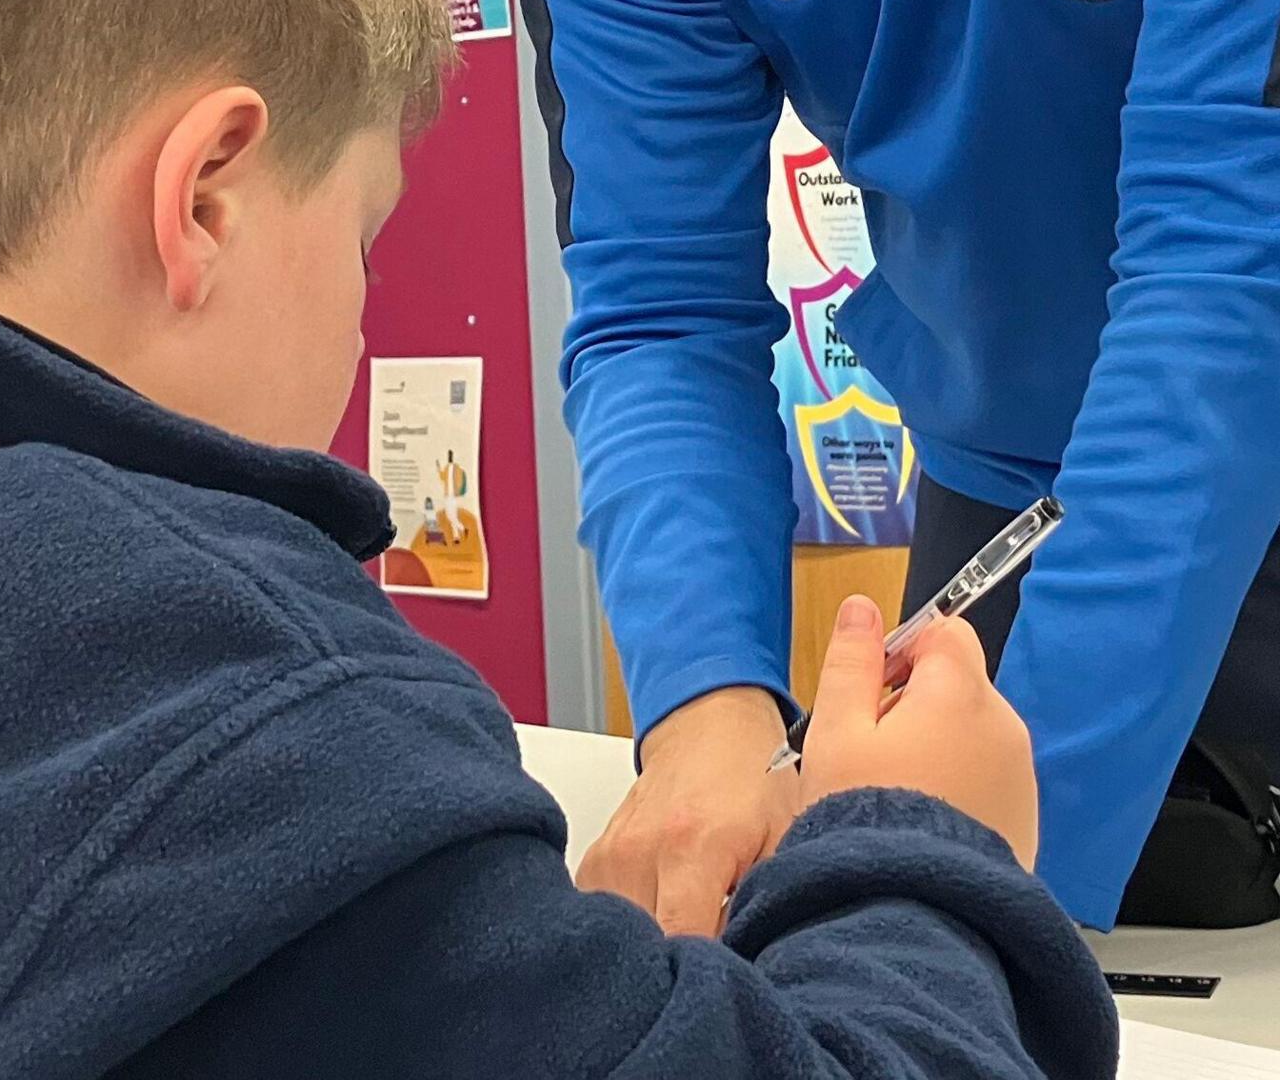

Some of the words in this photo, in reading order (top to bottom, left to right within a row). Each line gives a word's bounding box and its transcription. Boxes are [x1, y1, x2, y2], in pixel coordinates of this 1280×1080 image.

[798, 172, 842, 186] Outsta
[821, 190, 858, 206] Work
[822, 436, 850, 447] Other
[854, 441, 880, 453] ways
